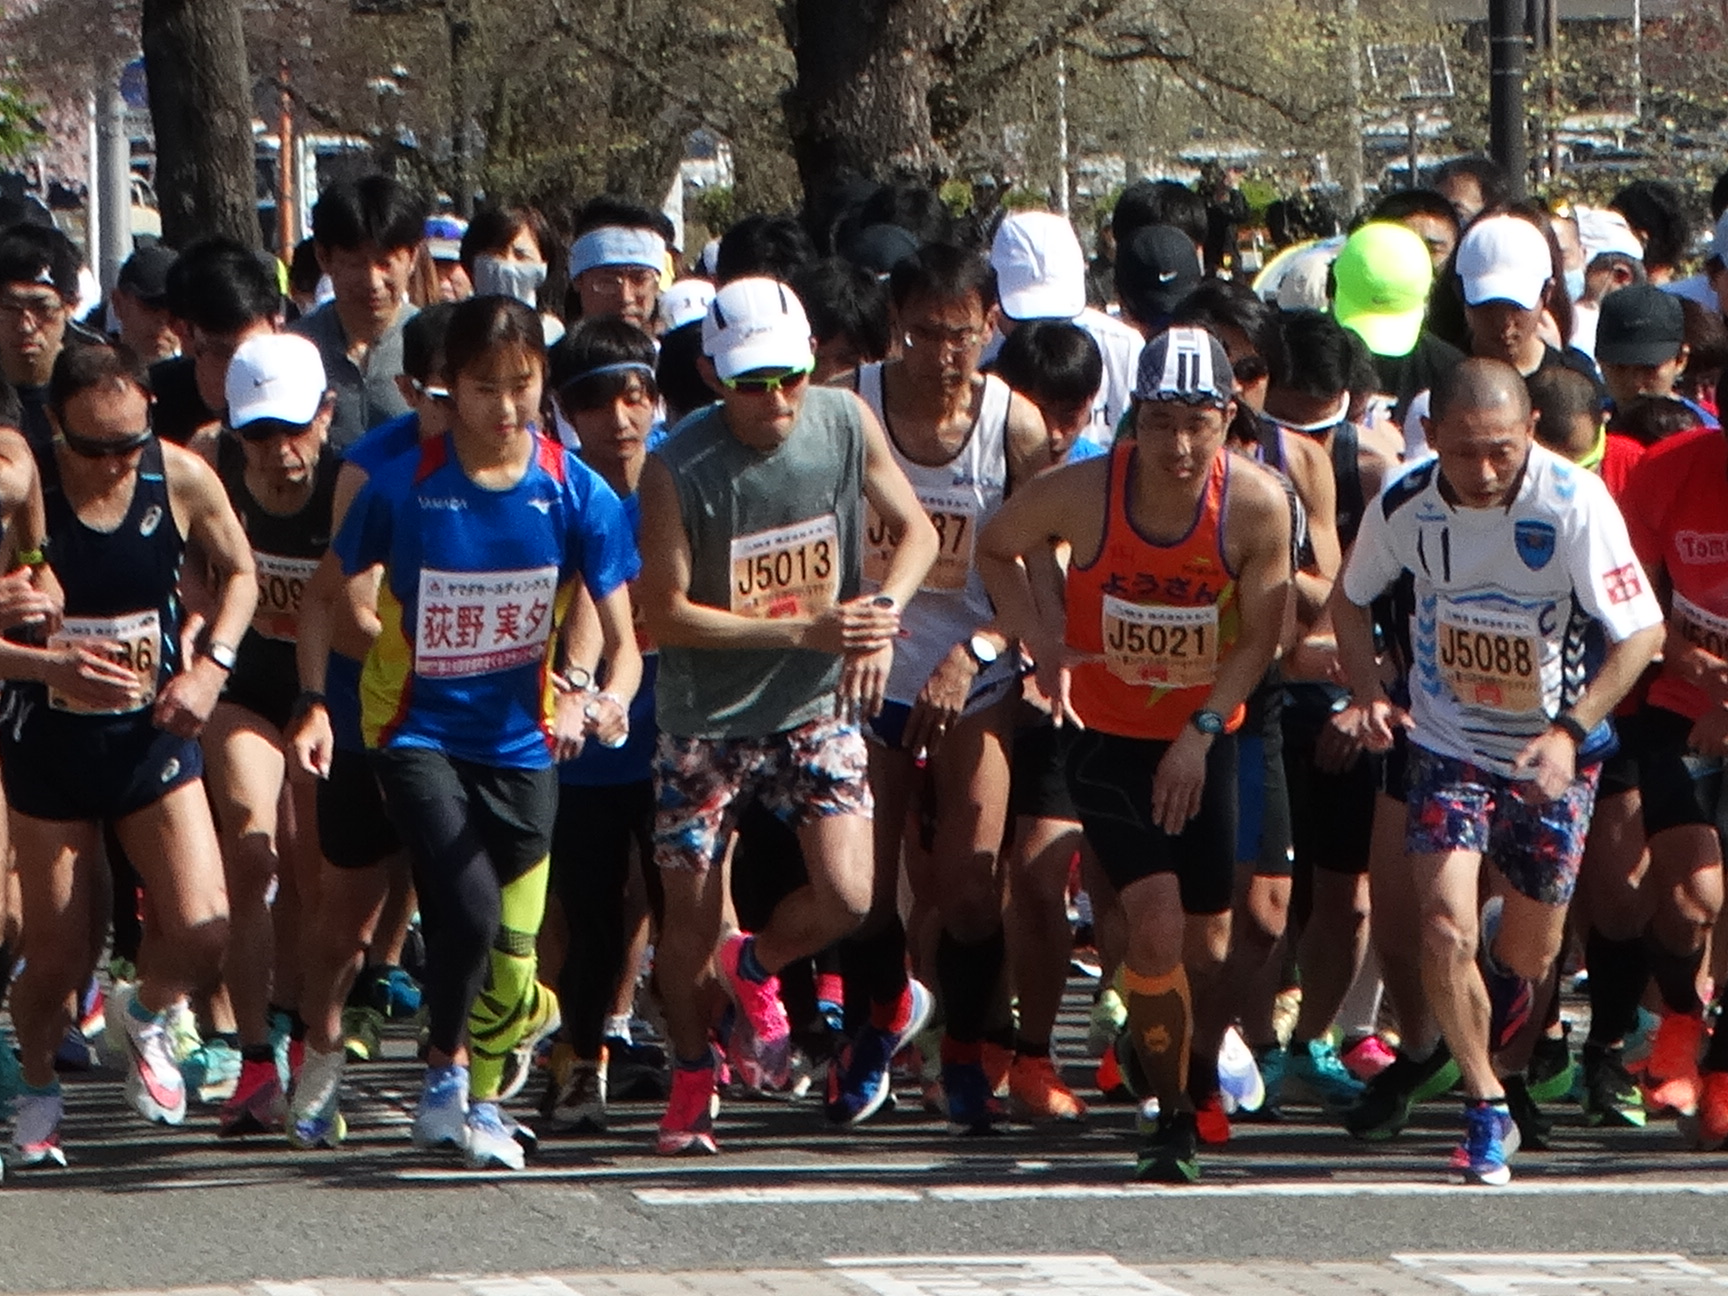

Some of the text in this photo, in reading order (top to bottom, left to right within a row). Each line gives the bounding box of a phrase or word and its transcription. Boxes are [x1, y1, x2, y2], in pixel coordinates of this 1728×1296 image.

[738, 540, 831, 595] J5013
[1100, 570, 1218, 608] ようさん
[1108, 621, 1206, 658] J5021
[1440, 627, 1533, 677] J5088
